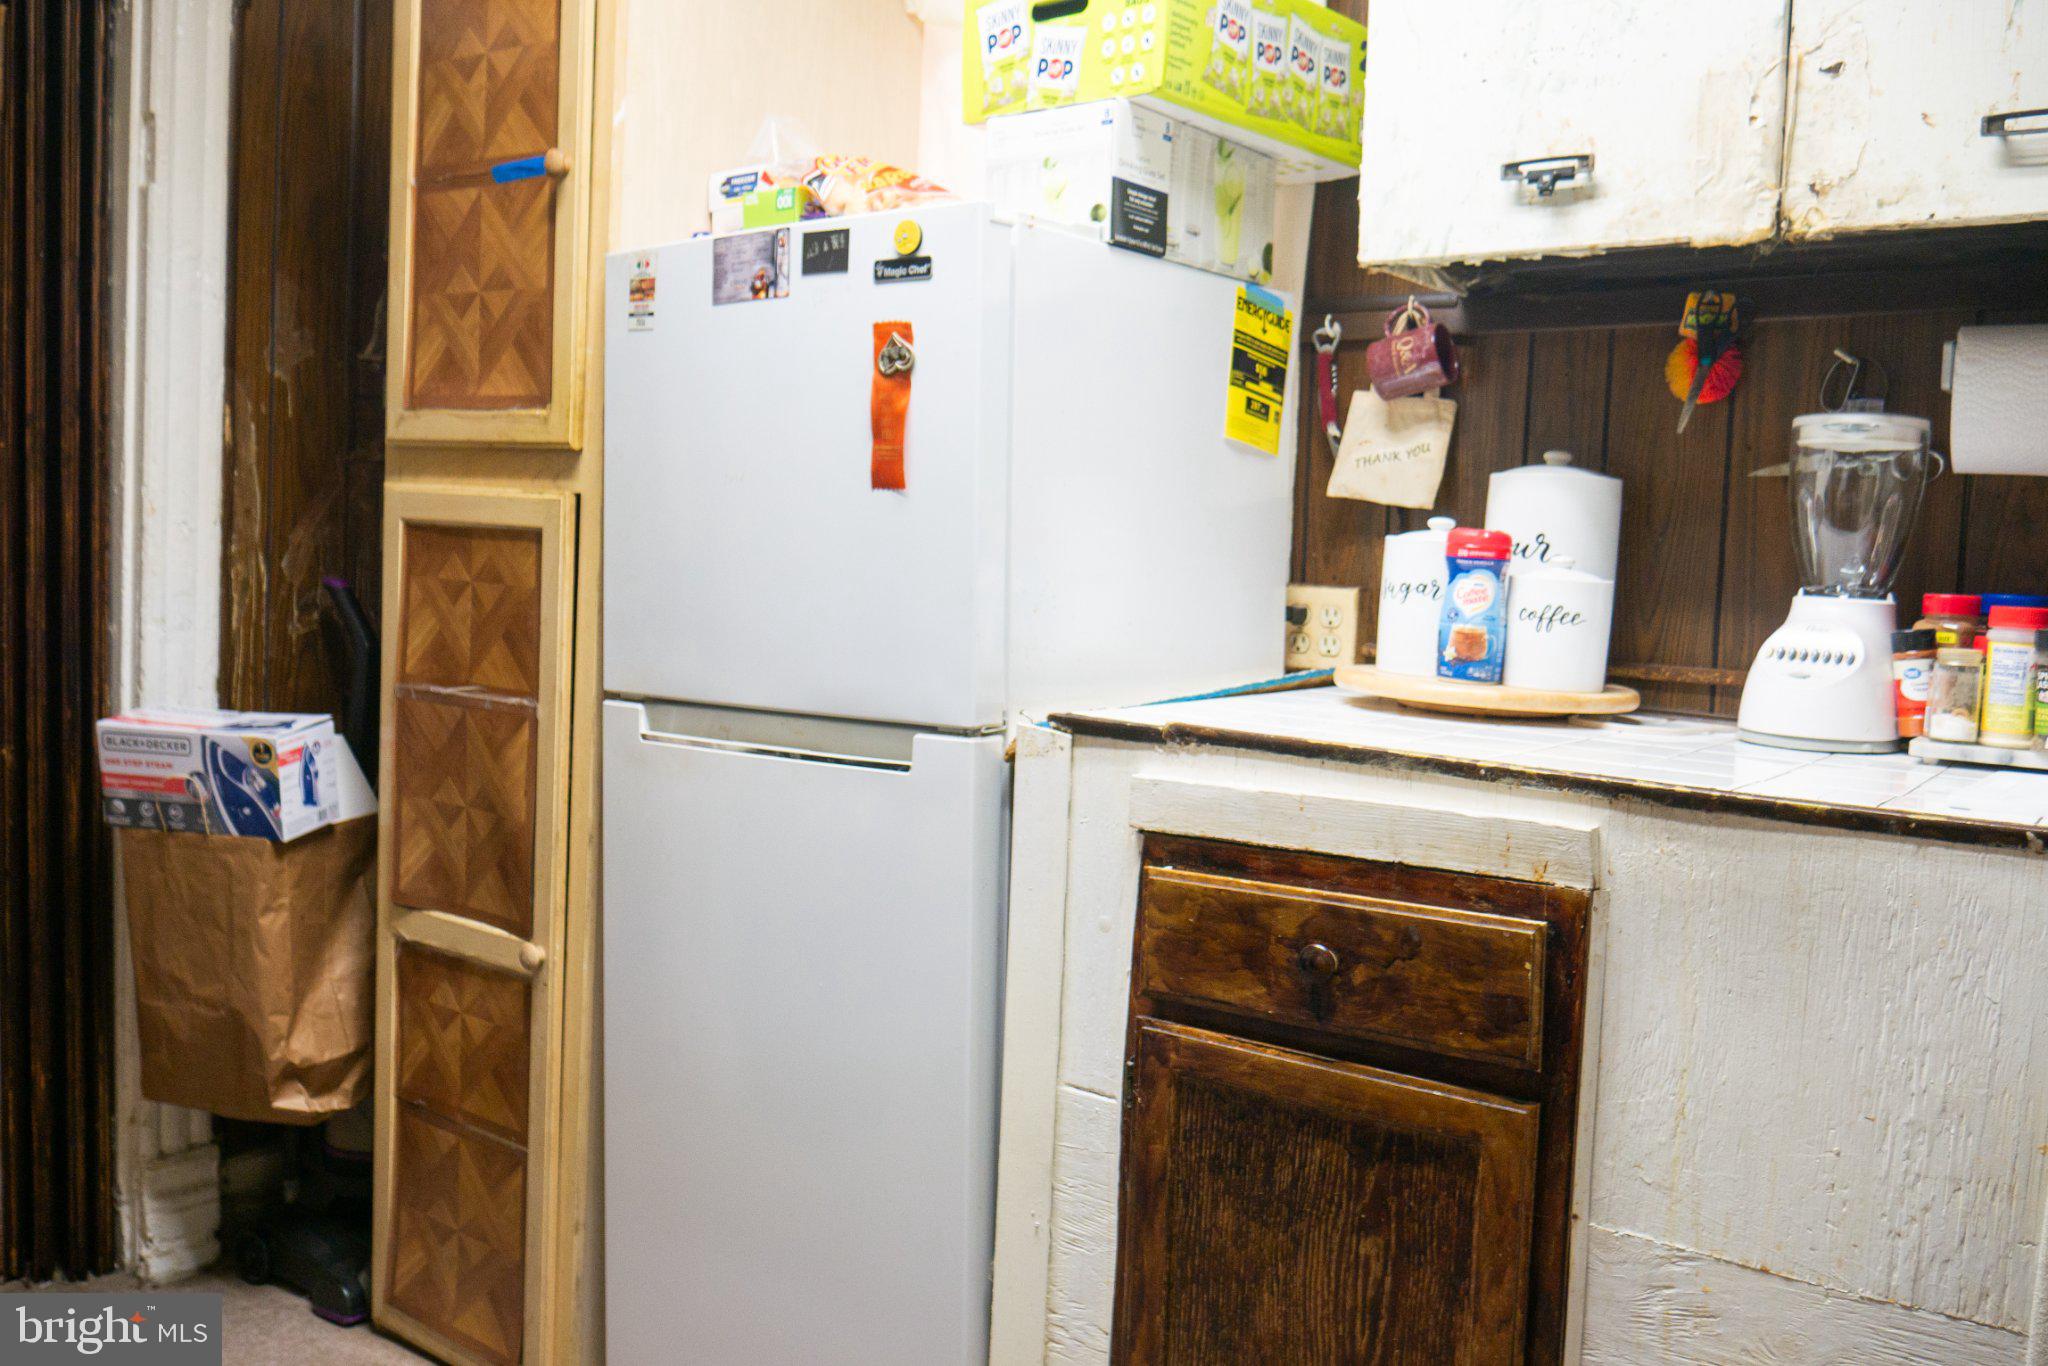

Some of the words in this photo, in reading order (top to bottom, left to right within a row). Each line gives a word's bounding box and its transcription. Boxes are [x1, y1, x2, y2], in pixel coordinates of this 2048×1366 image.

[884, 265, 907, 279] Magic
[1355, 451, 1400, 469] THANK
[1407, 442, 1431, 461] YOU
[1519, 605, 1587, 632] coffee
